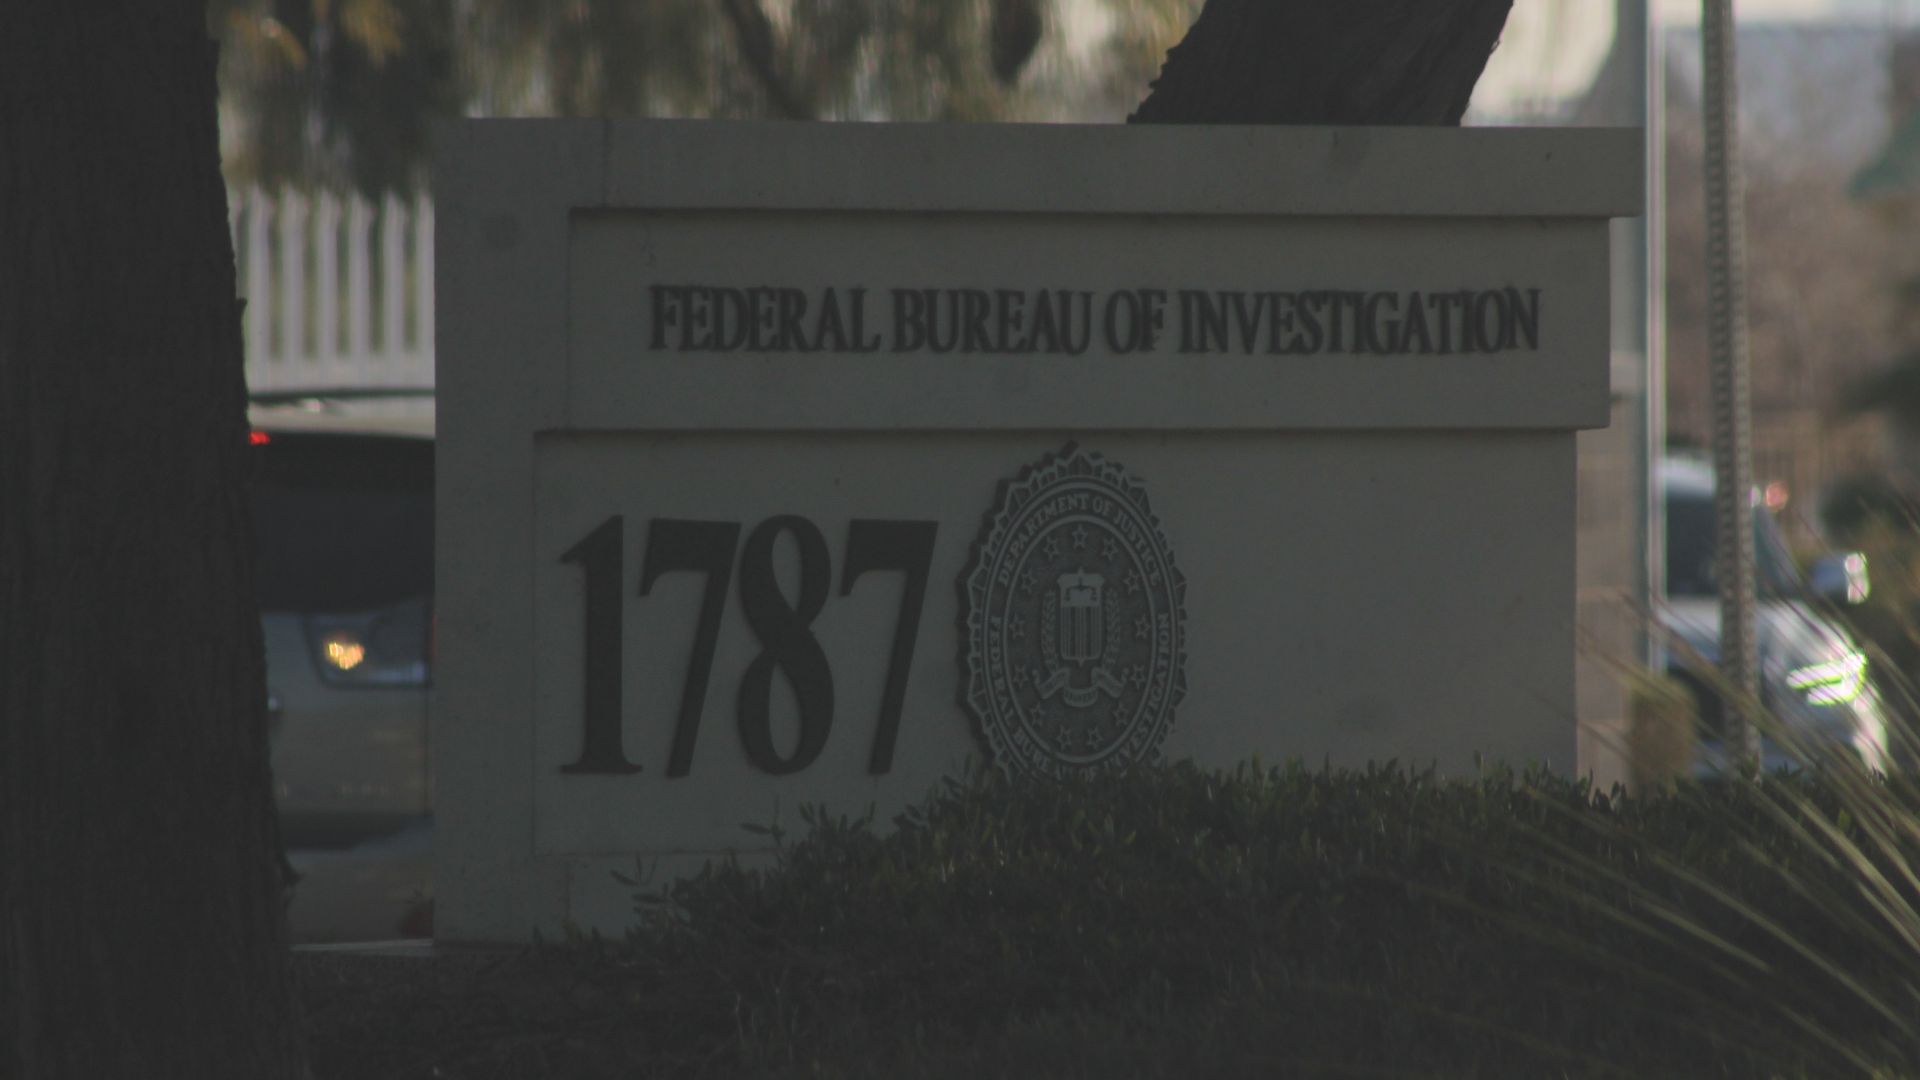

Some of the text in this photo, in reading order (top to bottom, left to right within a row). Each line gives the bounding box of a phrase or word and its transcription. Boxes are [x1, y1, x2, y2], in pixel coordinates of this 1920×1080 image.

[648, 284, 1541, 354] FEDERAL BUREAU OF INVESTIGATION
[998, 493, 1161, 587] DEPARTMENT OF JUSTICE
[558, 514, 939, 779] 1787
[990, 616, 1015, 725] FEDERAL
